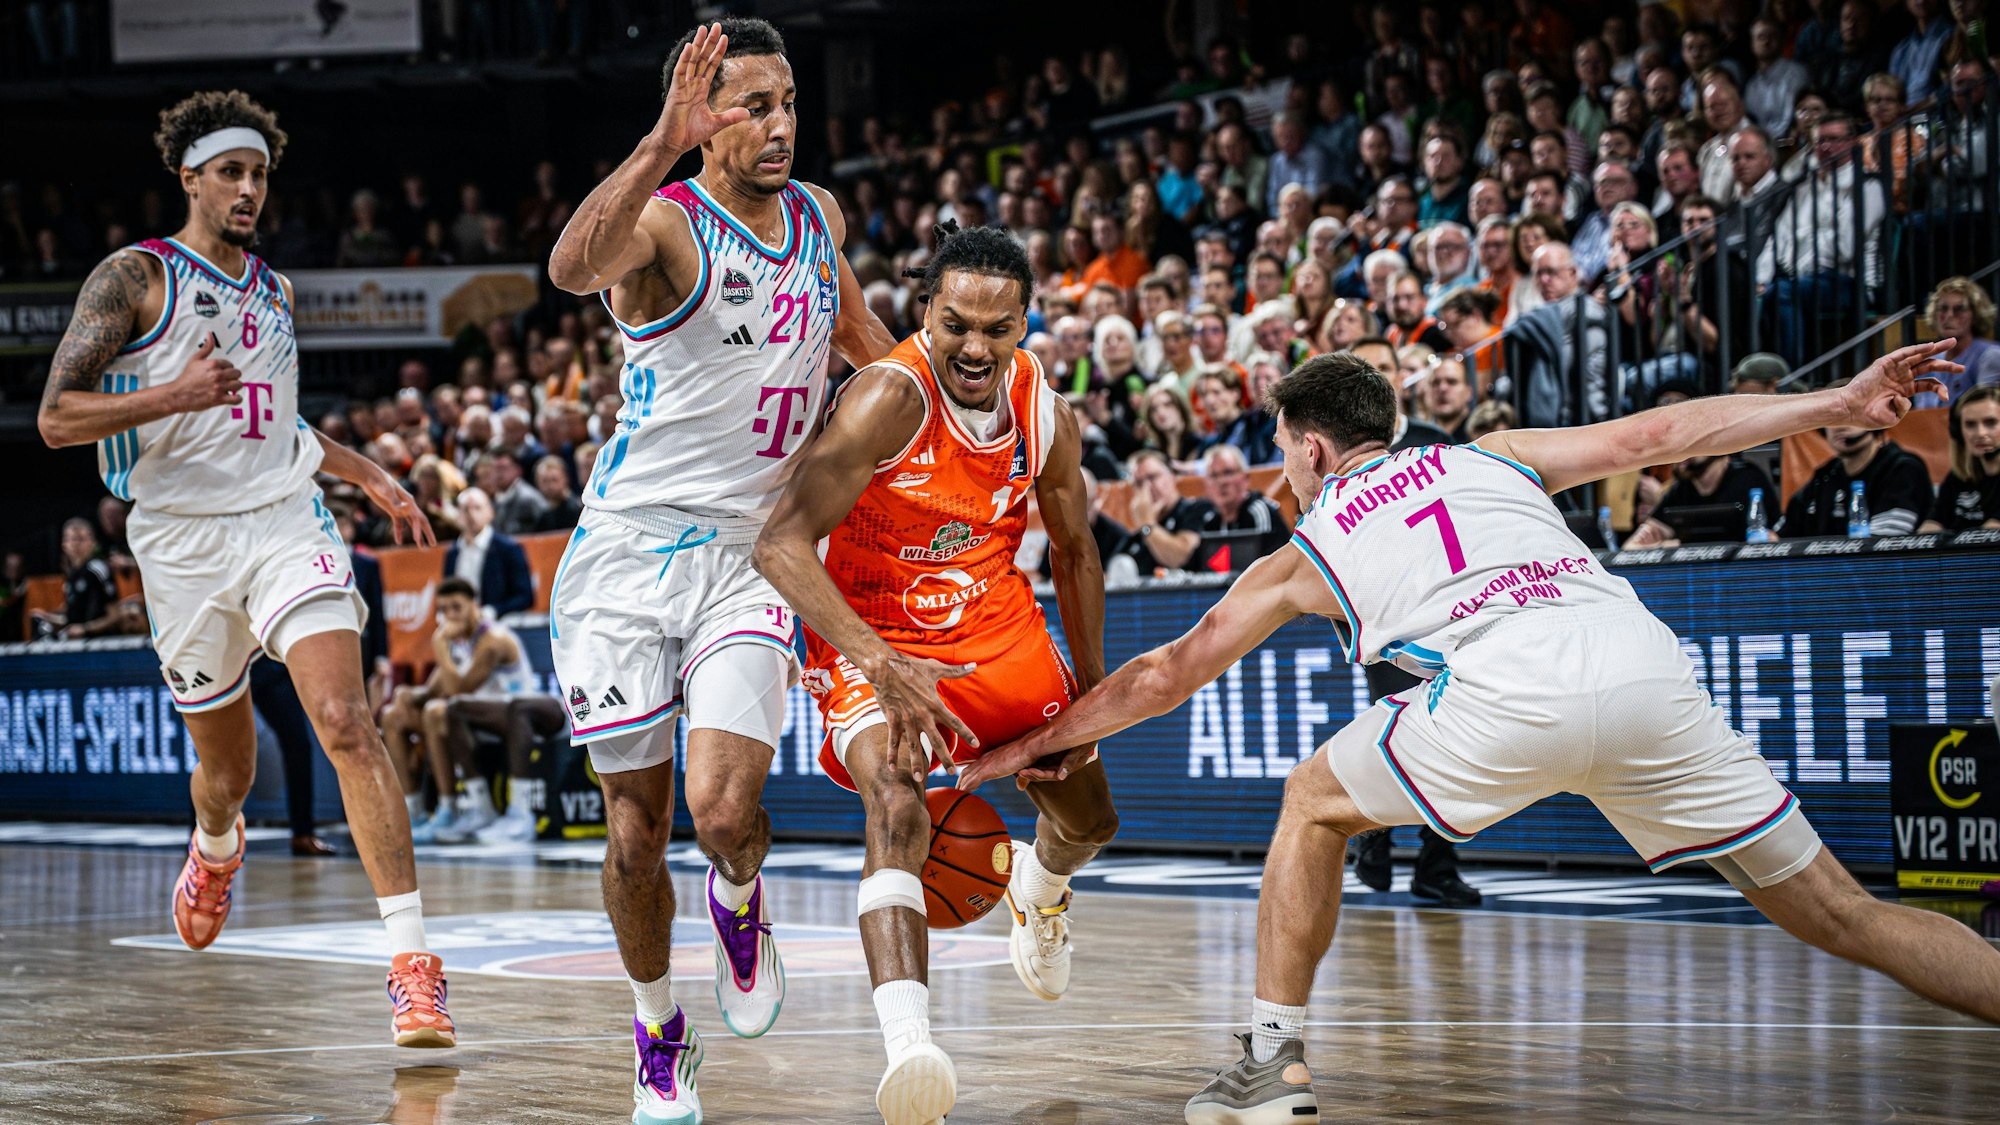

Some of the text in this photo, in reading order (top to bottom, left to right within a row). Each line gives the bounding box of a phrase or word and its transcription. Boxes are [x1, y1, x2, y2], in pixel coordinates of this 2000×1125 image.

[723, 287, 752, 297] BASKETS
[242, 312, 258, 349] 6
[769, 291, 809, 344] 21
[752, 386, 809, 459] T
[1334, 446, 1447, 535] MURPHY
[1404, 497, 1467, 575] 7
[1873, 533, 1938, 551] REFUEL
[915, 578, 988, 609] MIAVIT
[1450, 569, 1522, 620] ELEKOM
[1509, 582, 1563, 607] BONN
[1048, 642, 1071, 694] Sparkasse
[1188, 648, 1331, 778] ALLE
[1941, 757, 1977, 785] PSR
[560, 790, 601, 822] V12
[1894, 815, 2000, 862] V12 PR
